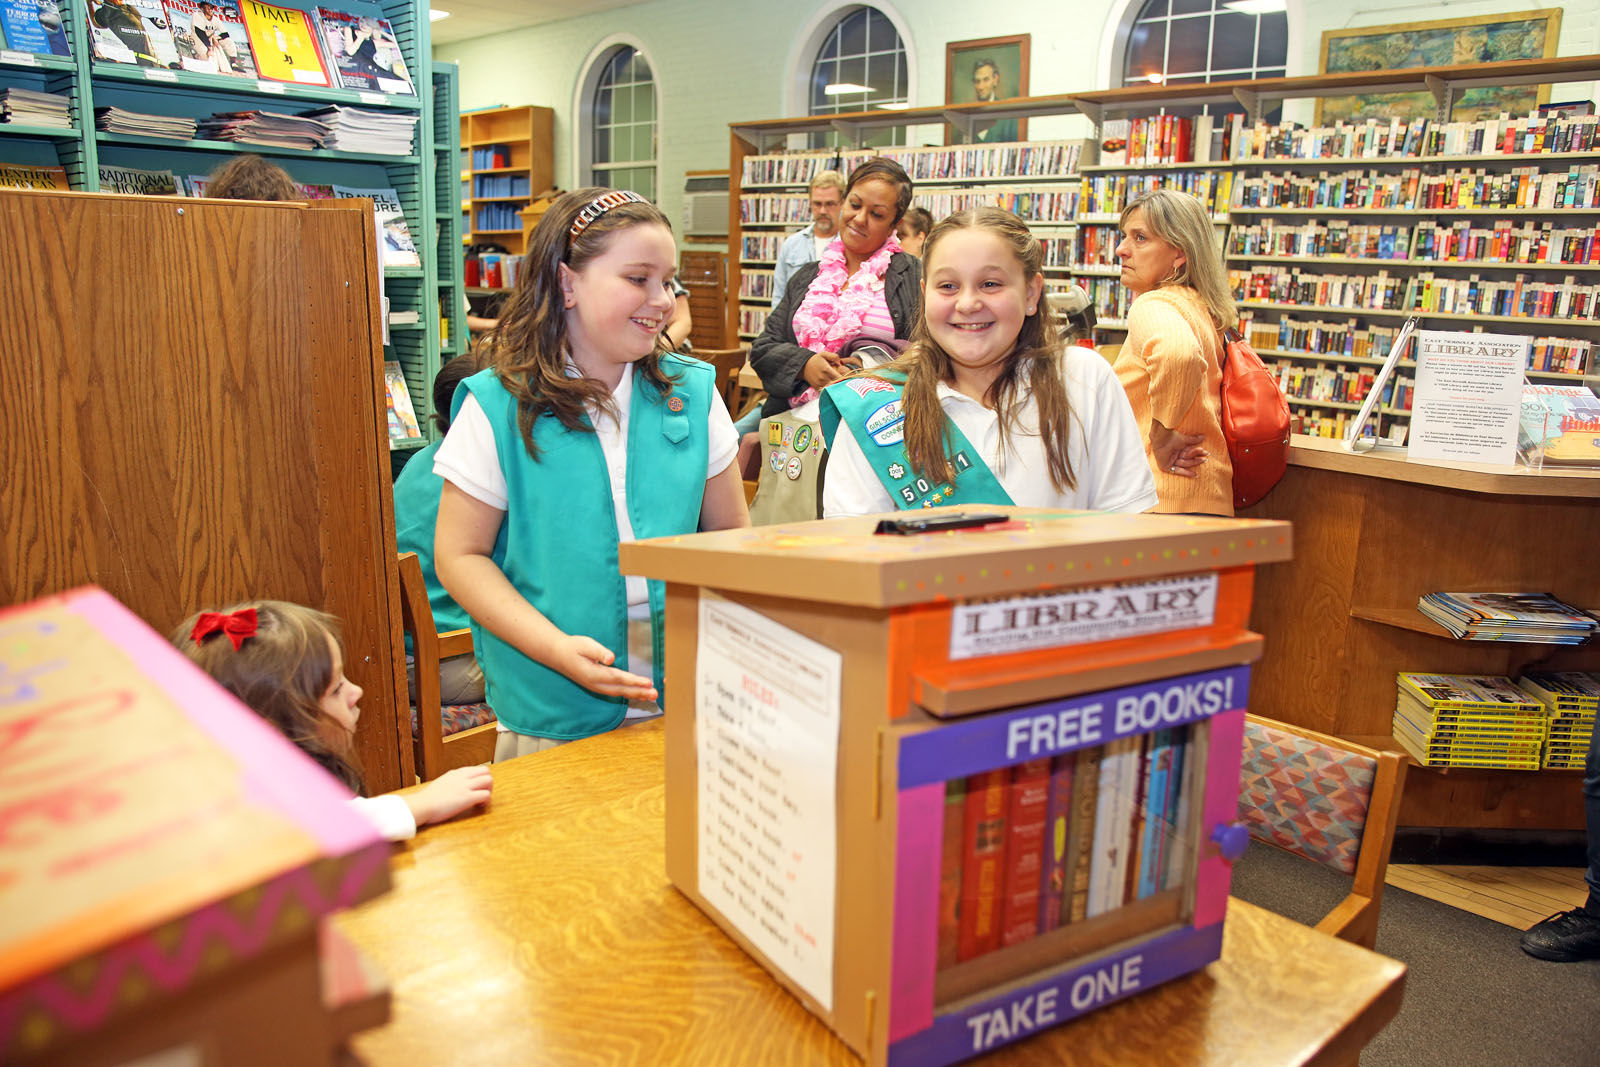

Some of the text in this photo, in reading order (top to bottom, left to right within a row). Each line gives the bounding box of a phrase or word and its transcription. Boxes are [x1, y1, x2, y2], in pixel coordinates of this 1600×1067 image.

[252, 3, 298, 25] TIME
[99, 168, 170, 187] RADITIONAL
[1424, 343, 1520, 358] LIBRARY
[868, 421, 884, 431] GIRL
[964, 585, 1209, 635] LIBRARY
[1007, 677, 1233, 758] FREE BOOKS!
[967, 956, 1143, 1051] TAKE ONE
